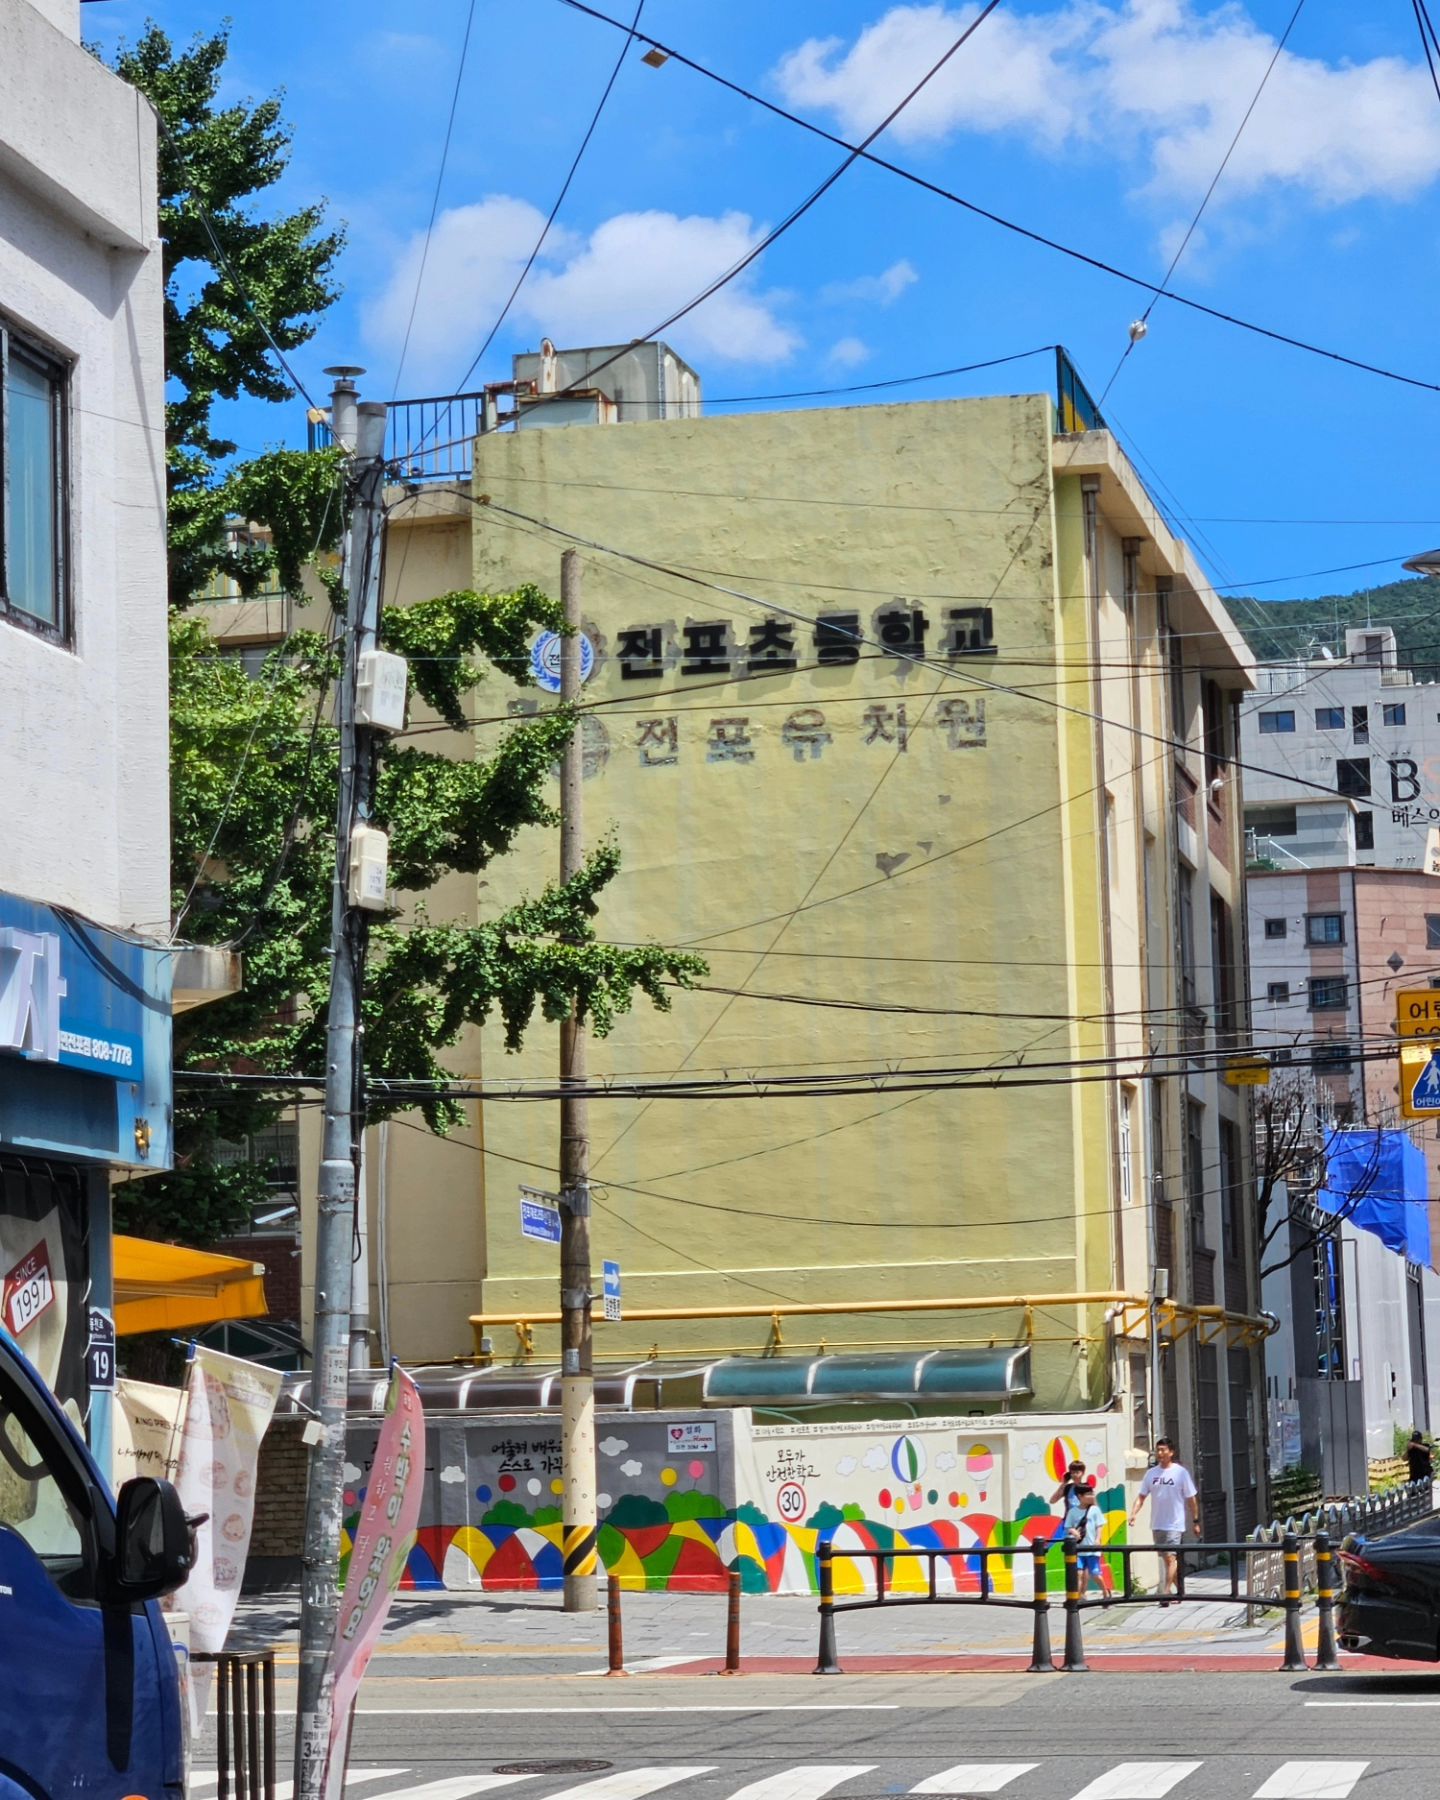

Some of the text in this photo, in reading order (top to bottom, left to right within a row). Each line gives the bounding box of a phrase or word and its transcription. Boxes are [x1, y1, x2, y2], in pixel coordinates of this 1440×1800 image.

[616, 607, 998, 680] 전포초등학교
[636, 697, 988, 767] 전포유치원
[15, 1257, 38, 1286] SINCE
[16, 1271, 47, 1322] 1997
[92, 1350, 109, 1379] 19
[498, 1458, 535, 1473] 스스로
[776, 1449, 806, 1466] 모두가
[1152, 1476, 1175, 1485] FILA
[782, 1491, 801, 1512] 30
